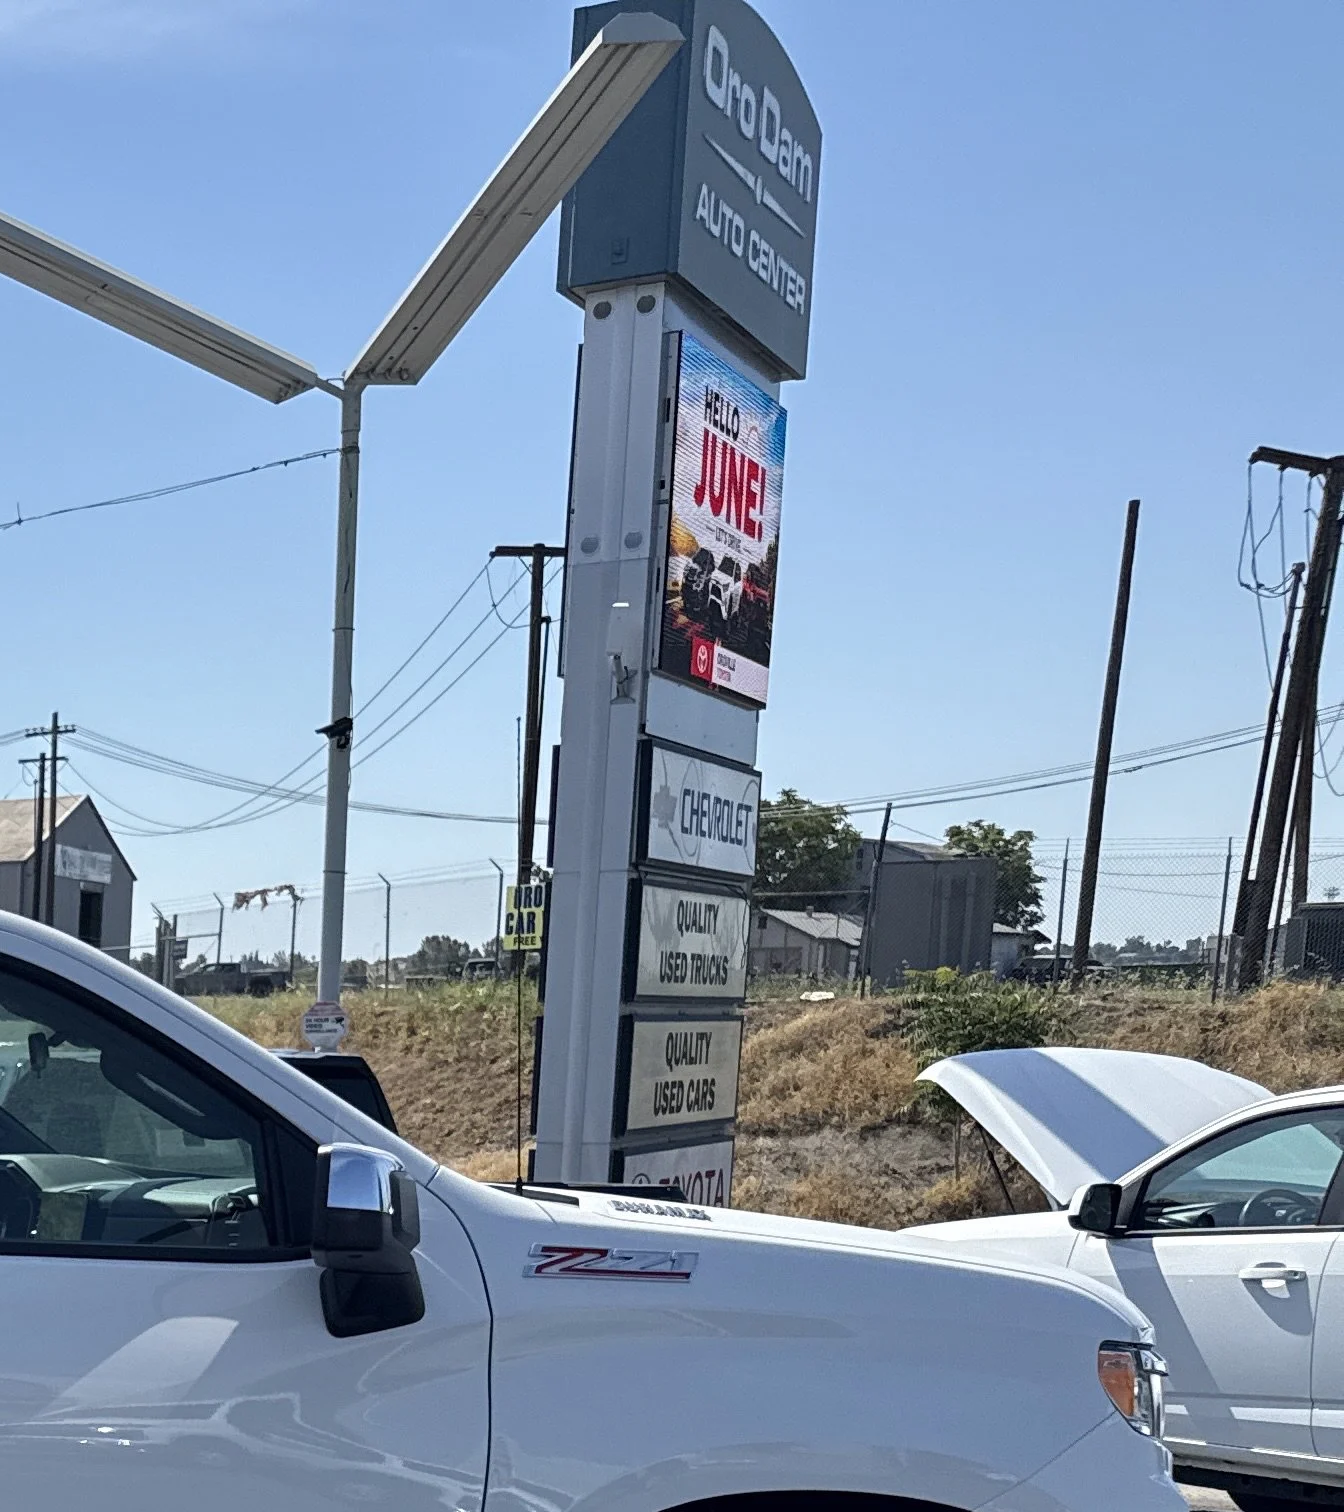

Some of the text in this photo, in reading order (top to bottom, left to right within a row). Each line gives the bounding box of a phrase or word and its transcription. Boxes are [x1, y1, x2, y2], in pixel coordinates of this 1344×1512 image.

[702, 24, 813, 204] Oro Dam
[695, 182, 807, 316] AUTO CENTER
[704, 384, 741, 442] HELLO
[693, 426, 767, 543] JUNE!
[679, 787, 753, 847] CHEVROLET
[505, 911, 536, 936] CAR
[676, 899, 720, 937] QUALITY
[659, 951, 729, 987] USED TRUCKS
[665, 1031, 712, 1068] QUALITY
[653, 1077, 716, 1117] USED CARS
[659, 1168, 724, 1208] YOTA
